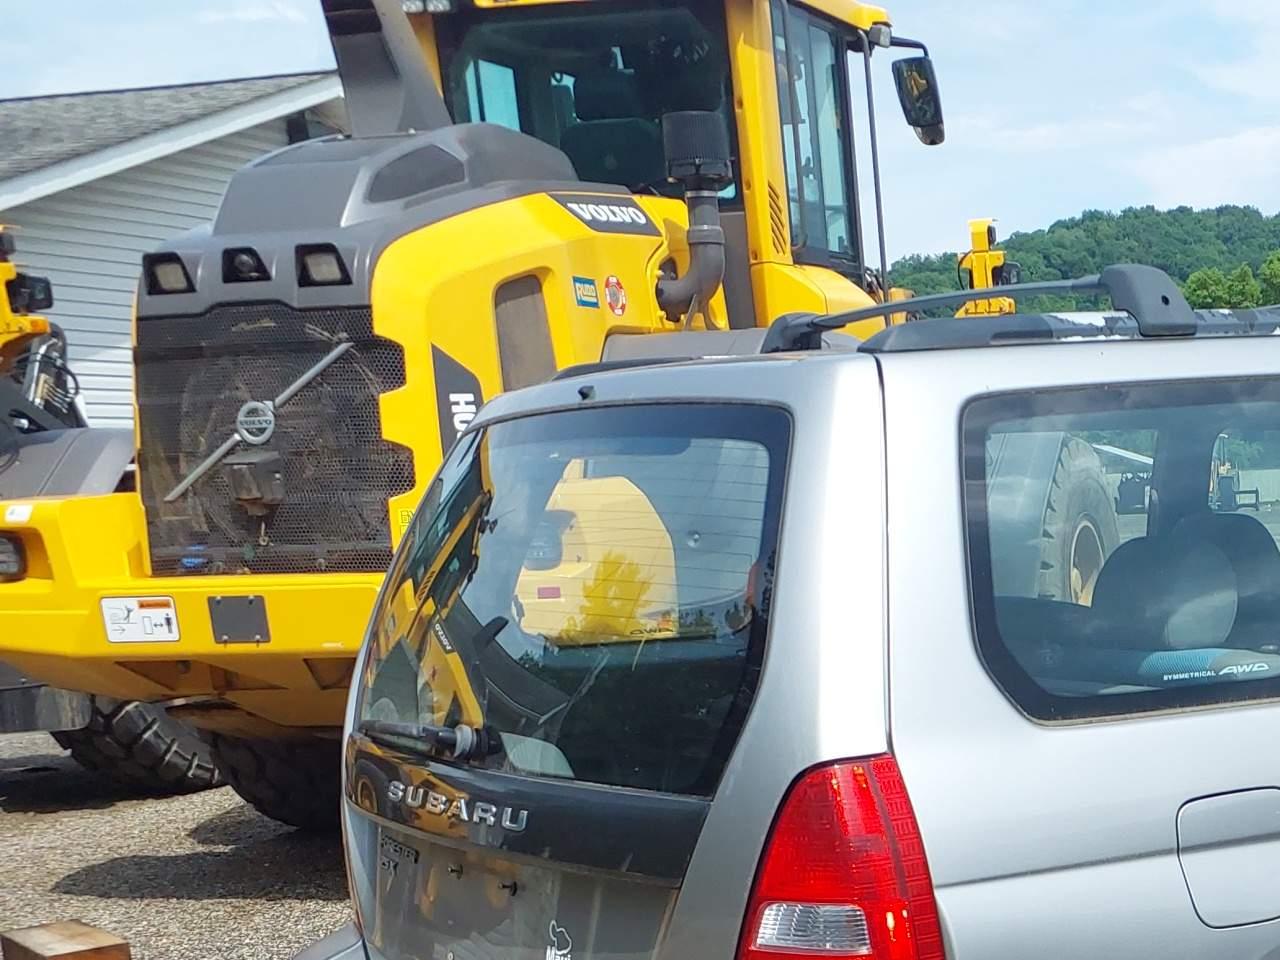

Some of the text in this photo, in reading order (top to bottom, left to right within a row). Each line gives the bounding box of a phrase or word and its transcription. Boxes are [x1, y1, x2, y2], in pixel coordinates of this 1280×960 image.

[567, 203, 647, 224] VOLVO
[1163, 662, 1270, 681] SYMMETRICAL AWD
[387, 780, 529, 832] SUBARU
